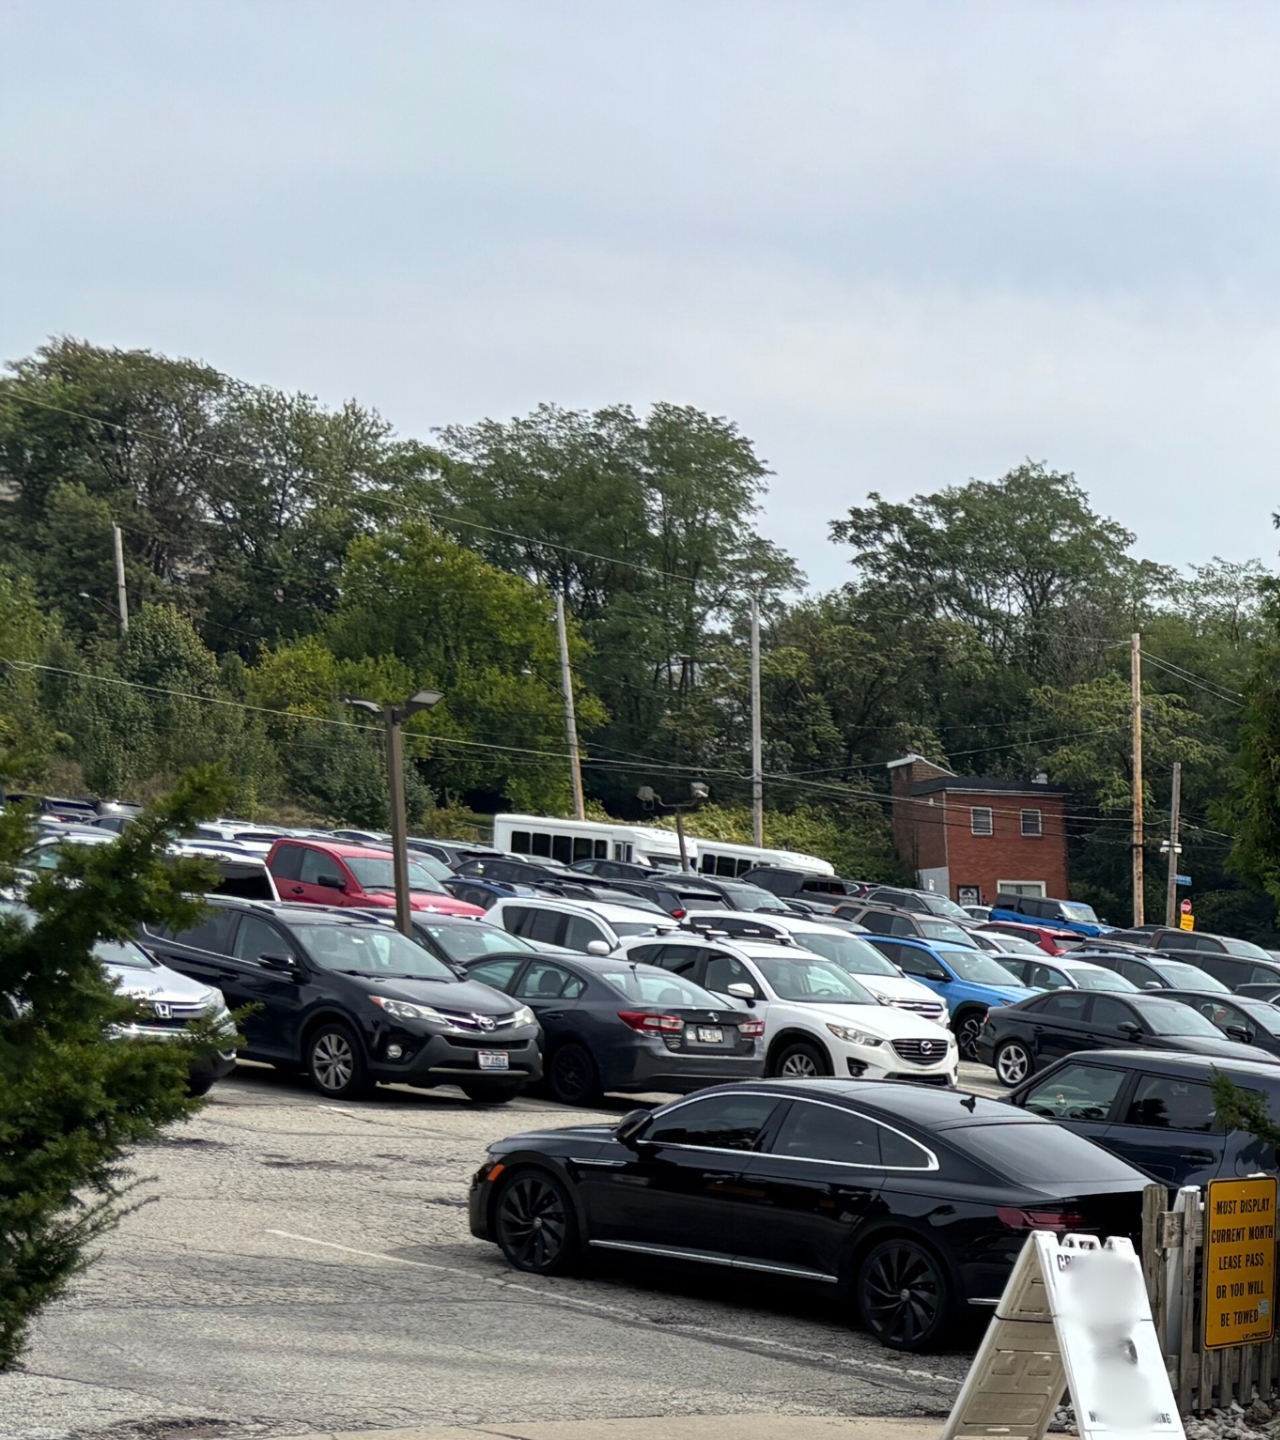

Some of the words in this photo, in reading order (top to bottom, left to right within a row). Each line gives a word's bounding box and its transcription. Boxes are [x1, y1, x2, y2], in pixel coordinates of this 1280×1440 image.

[1216, 1200, 1237, 1215] MUST
[1240, 1197, 1270, 1214] DISPLAY
[1211, 1227, 1246, 1244] CURRENT
[1248, 1225, 1273, 1241] MONTH
[1219, 1254, 1242, 1271] LEASE
[1245, 1252, 1265, 1268] PASS
[1216, 1284, 1227, 1299] OR
[1230, 1282, 1245, 1297] YOU
[1247, 1280, 1265, 1295] WILL
[1220, 1312, 1230, 1328] BE
[1233, 1308, 1259, 1326] TOWED
